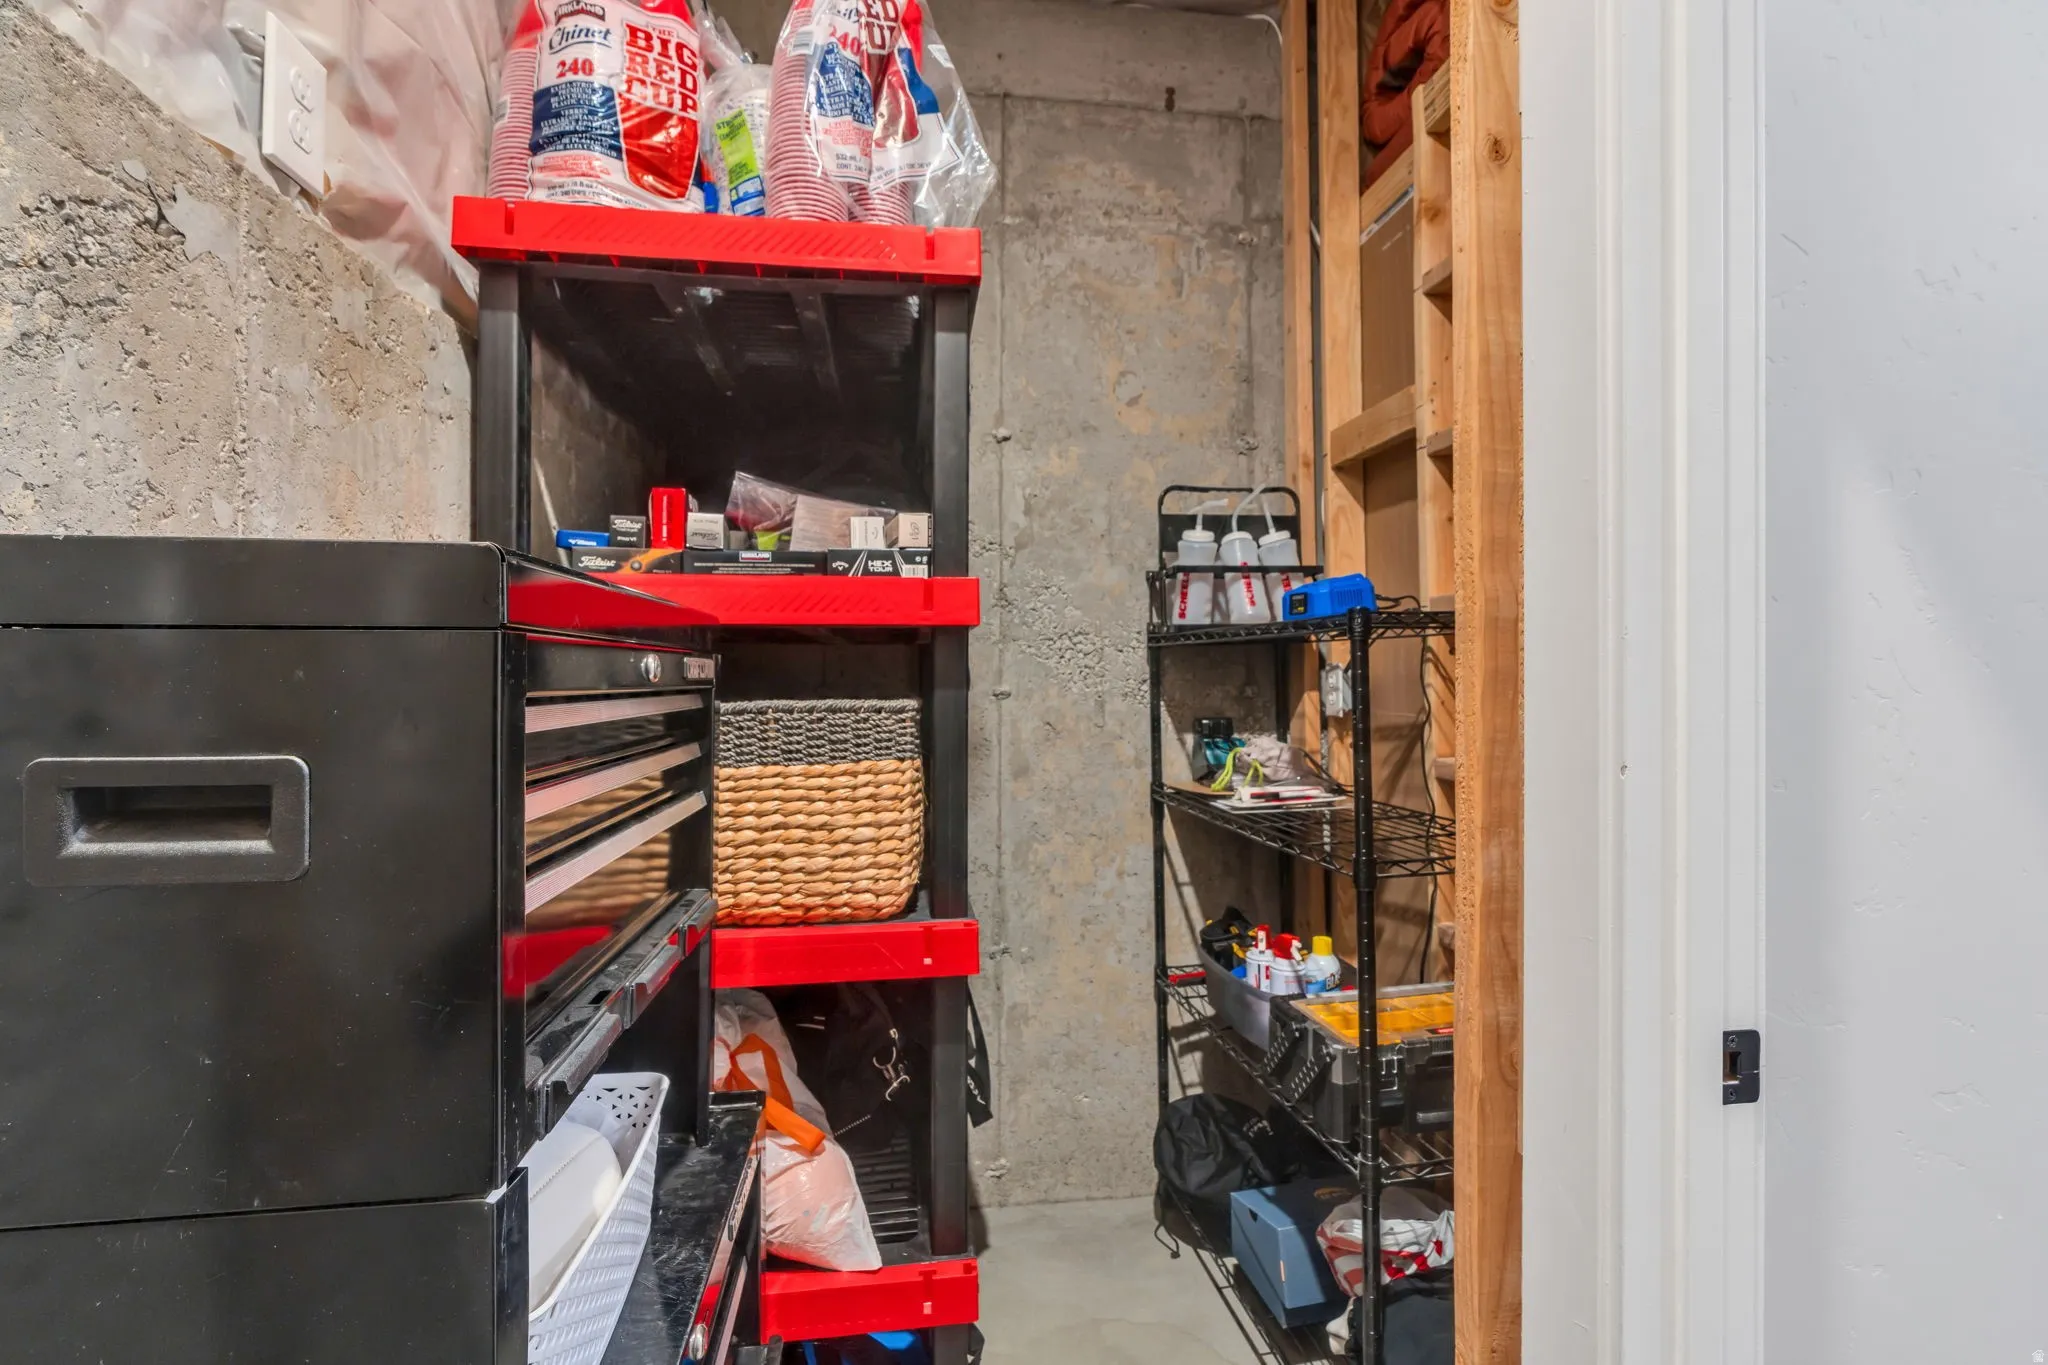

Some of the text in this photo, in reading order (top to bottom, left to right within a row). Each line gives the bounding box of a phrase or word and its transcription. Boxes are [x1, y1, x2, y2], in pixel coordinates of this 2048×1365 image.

[549, 24, 612, 50] Chinet
[626, 23, 698, 72] BIG
[556, 57, 595, 78] 240
[626, 50, 698, 96] RED
[625, 75, 698, 113] CUP
[578, 556, 616, 567] Titleist
